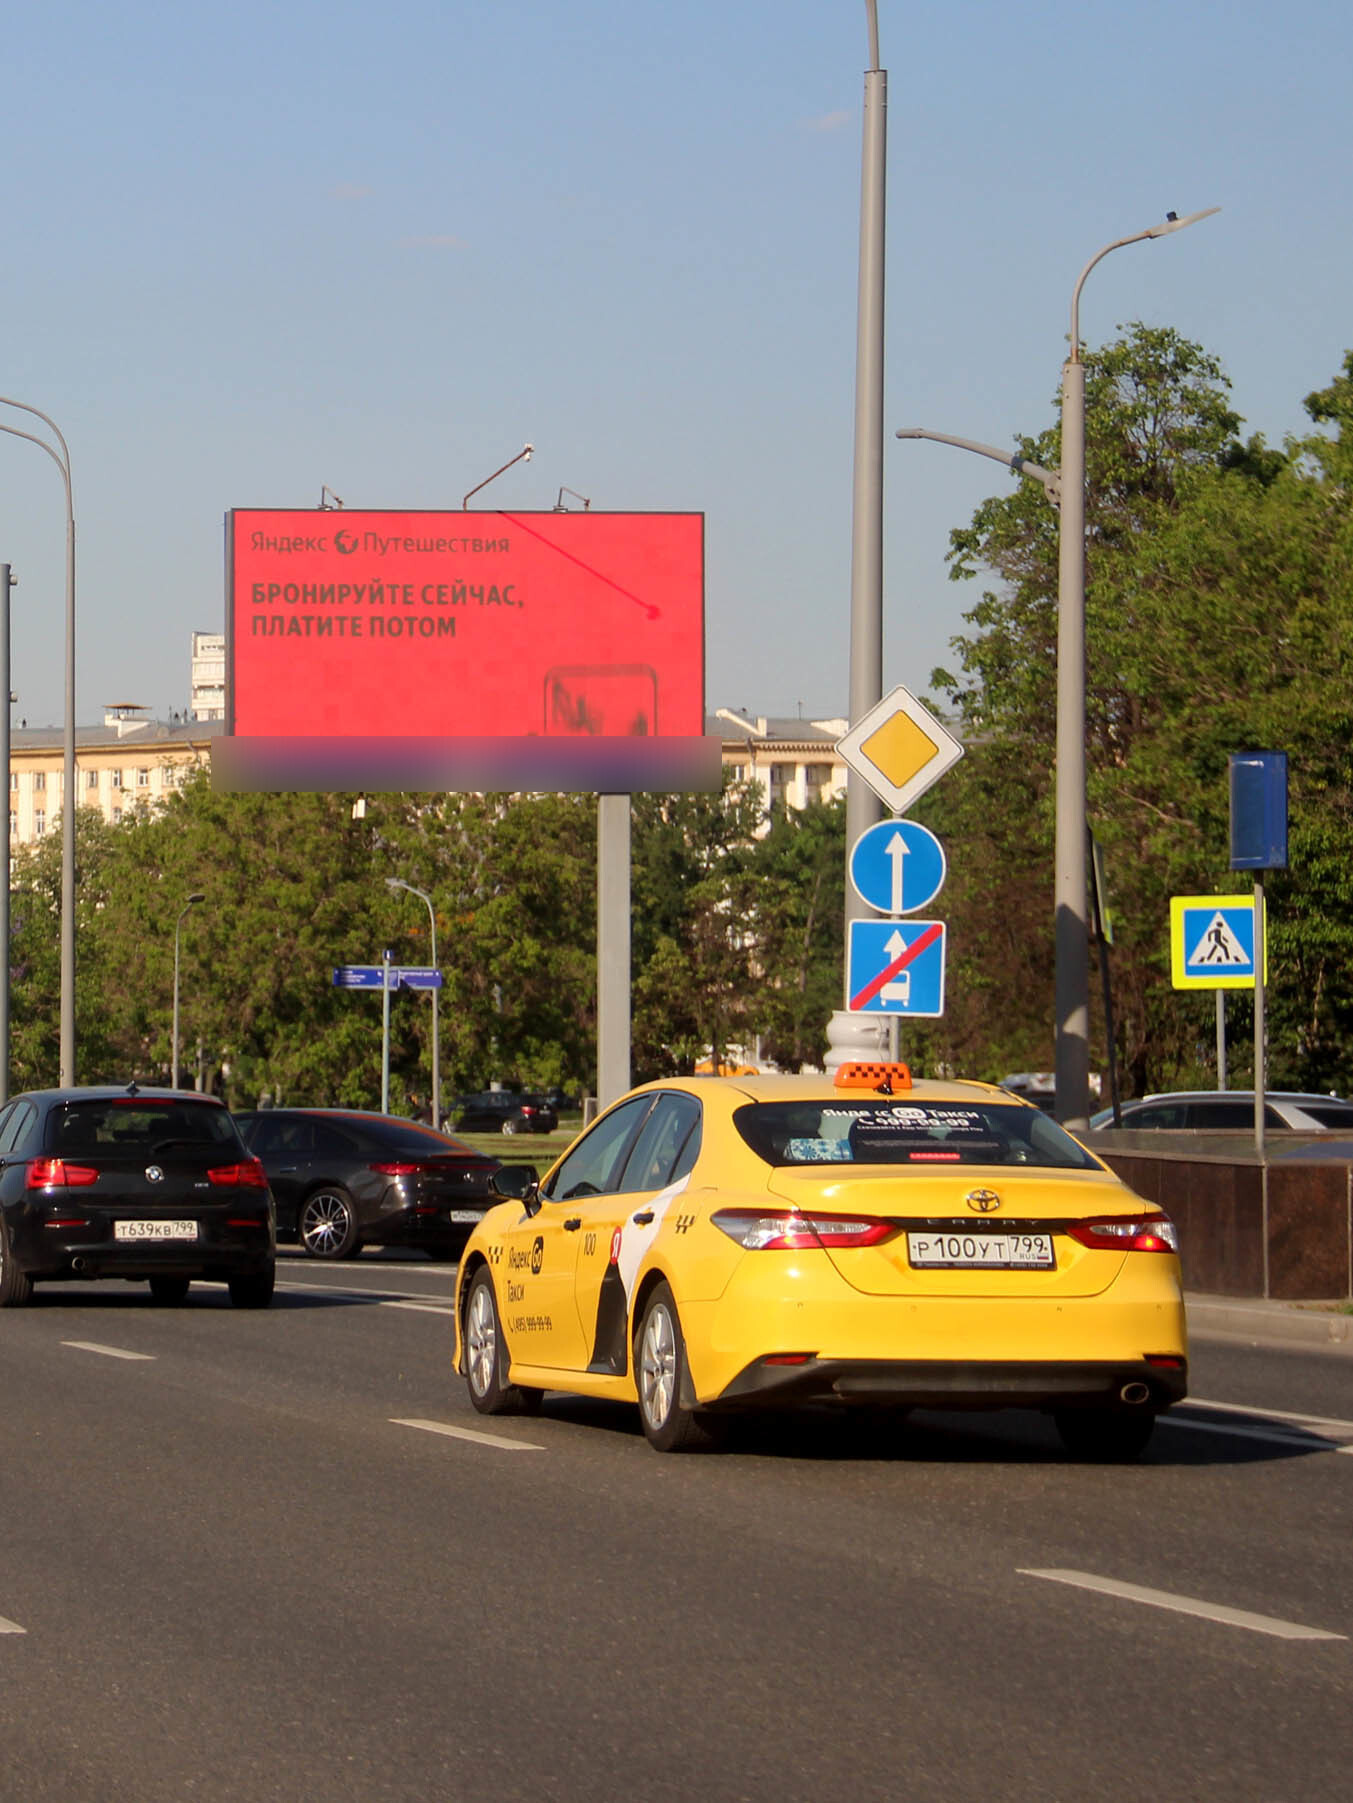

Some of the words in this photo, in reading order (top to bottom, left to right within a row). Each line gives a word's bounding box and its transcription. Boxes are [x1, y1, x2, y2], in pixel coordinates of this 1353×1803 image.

[250, 530, 327, 554] Яндекс
[364, 531, 510, 556] Путешествия
[252, 578, 415, 605] БРОНИРУЙТЕ
[421, 579, 524, 609] СЕЙЧАС,
[252, 615, 363, 637] ПЛАТИТЕ
[369, 615, 456, 638] ПОТОМ
[926, 1109, 980, 1120] Такси
[584, 1233, 596, 1256] 100
[1010, 1236, 1045, 1253] 799
[509, 1246, 531, 1272] Яндекс
[507, 1280, 525, 1302] Такси
